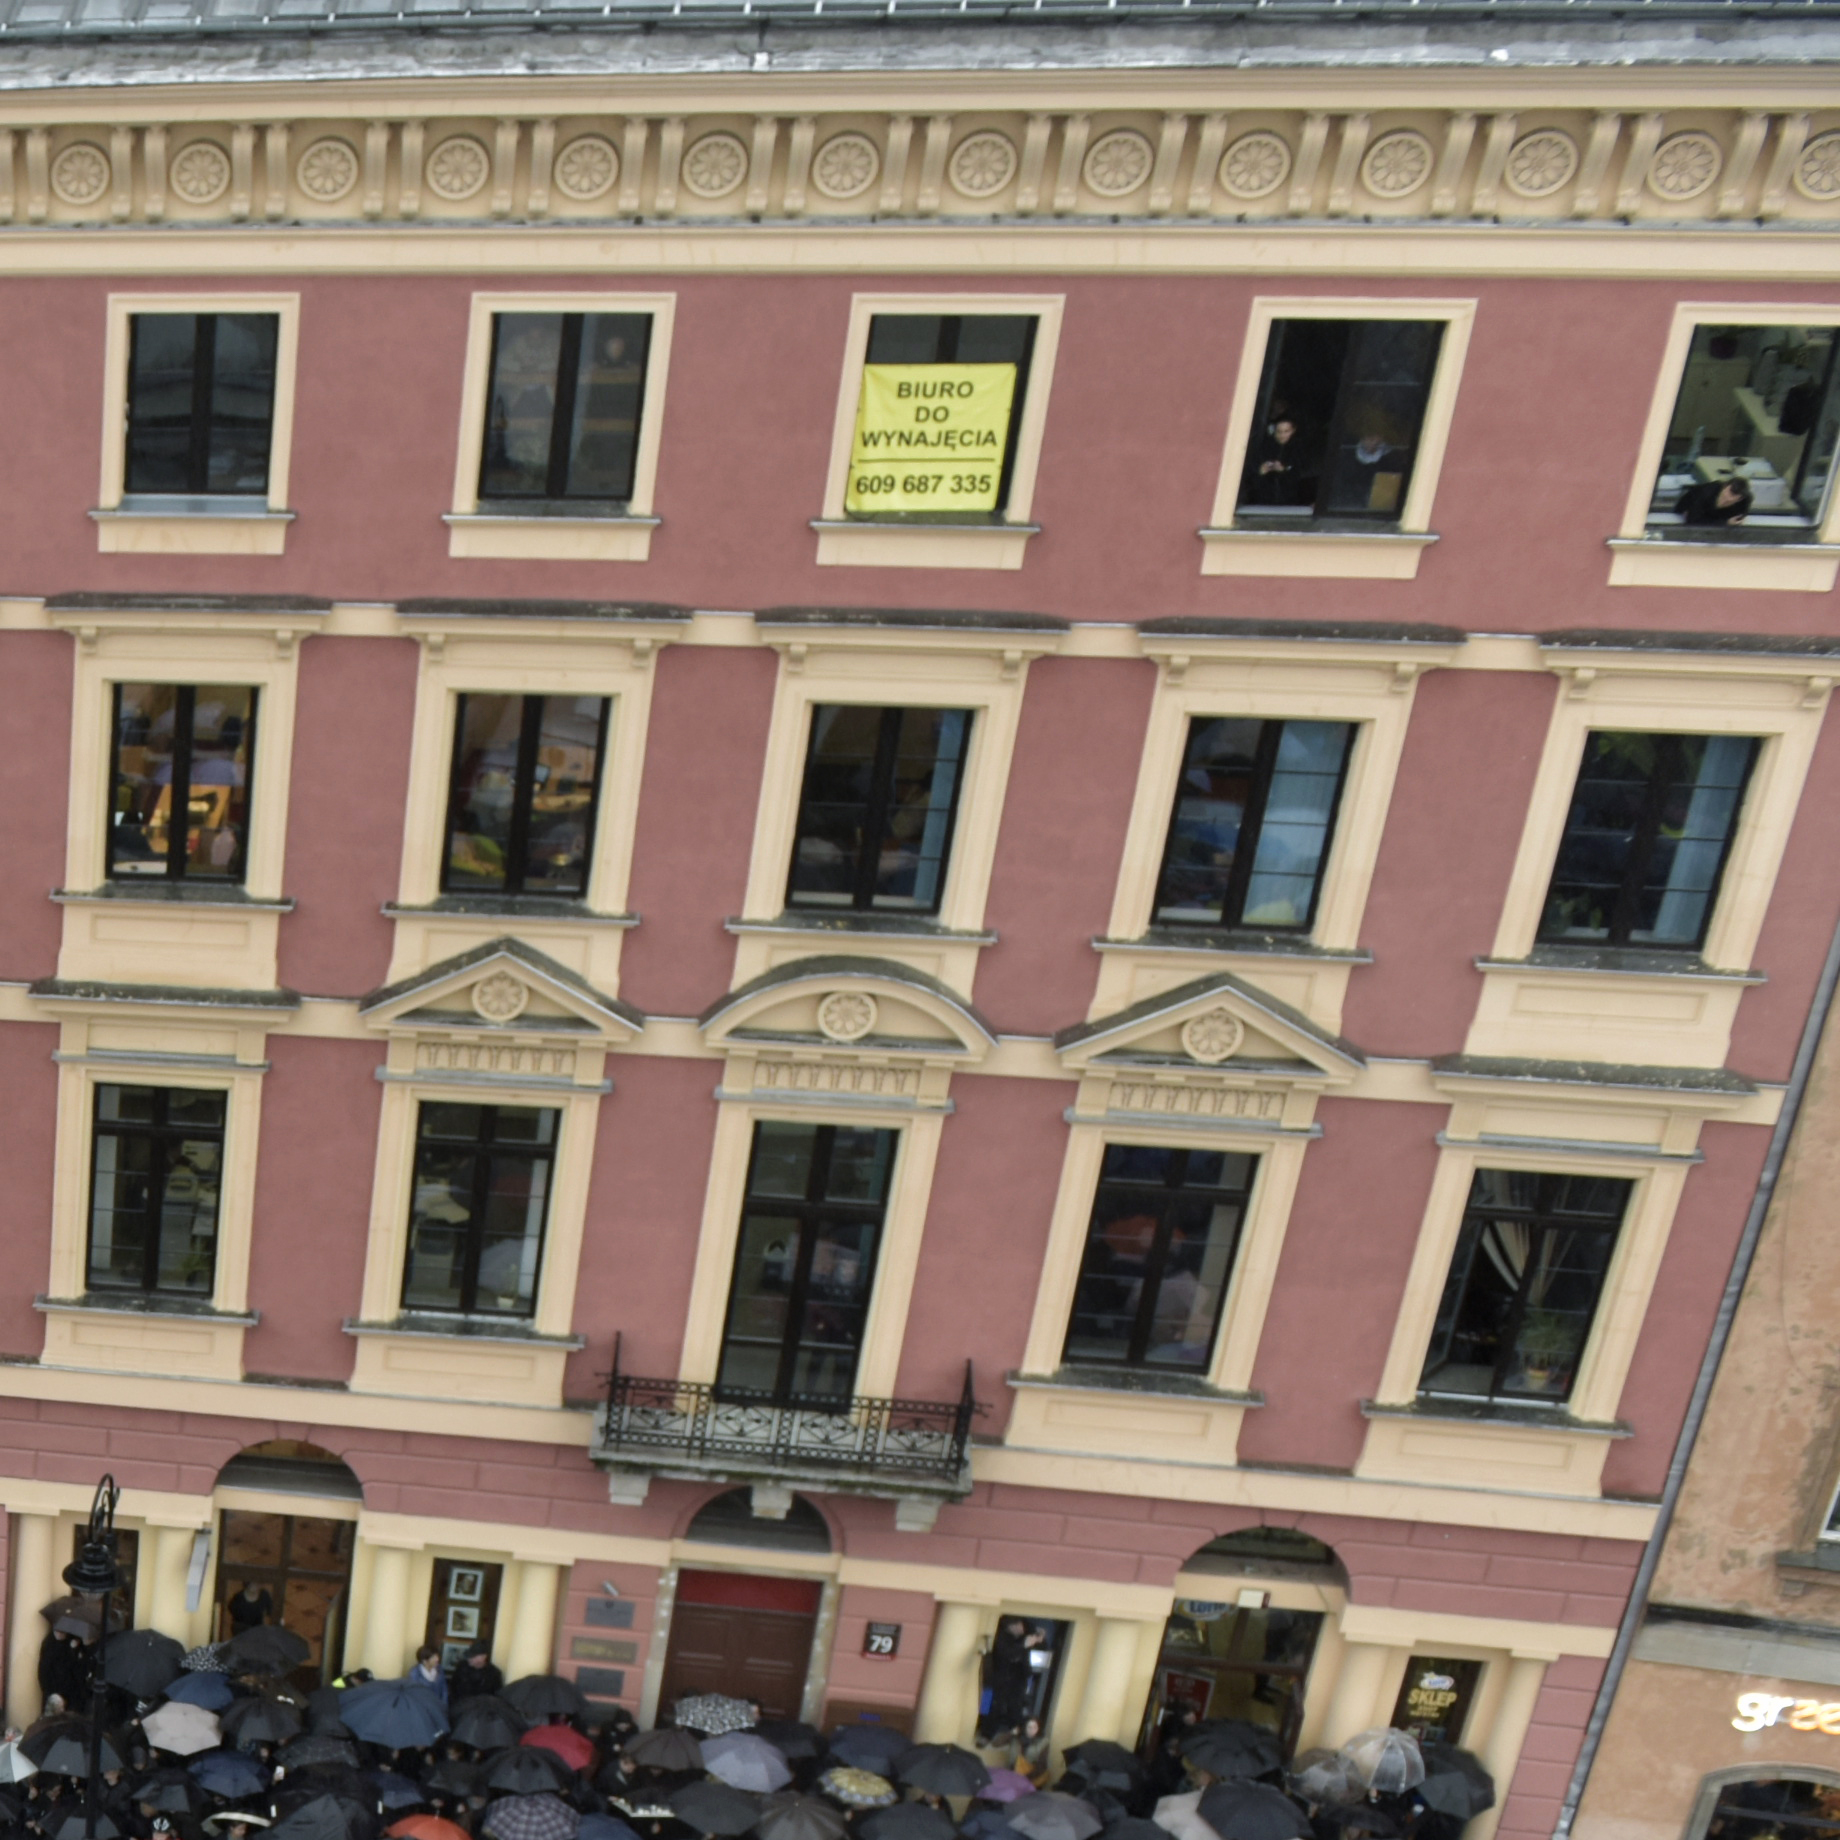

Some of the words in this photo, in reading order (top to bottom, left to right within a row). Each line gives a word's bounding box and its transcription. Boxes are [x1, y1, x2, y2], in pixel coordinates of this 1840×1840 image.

[897, 381, 974, 399] BIURO
[915, 406, 950, 423] DO
[861, 430, 998, 451] WYNAJĘCIA
[856, 475, 895, 495] 609
[902, 475, 944, 494] 687
[950, 475, 992, 494] 335
[869, 1634, 893, 1654] 79
[1407, 1688, 1457, 1707] SKLEP
